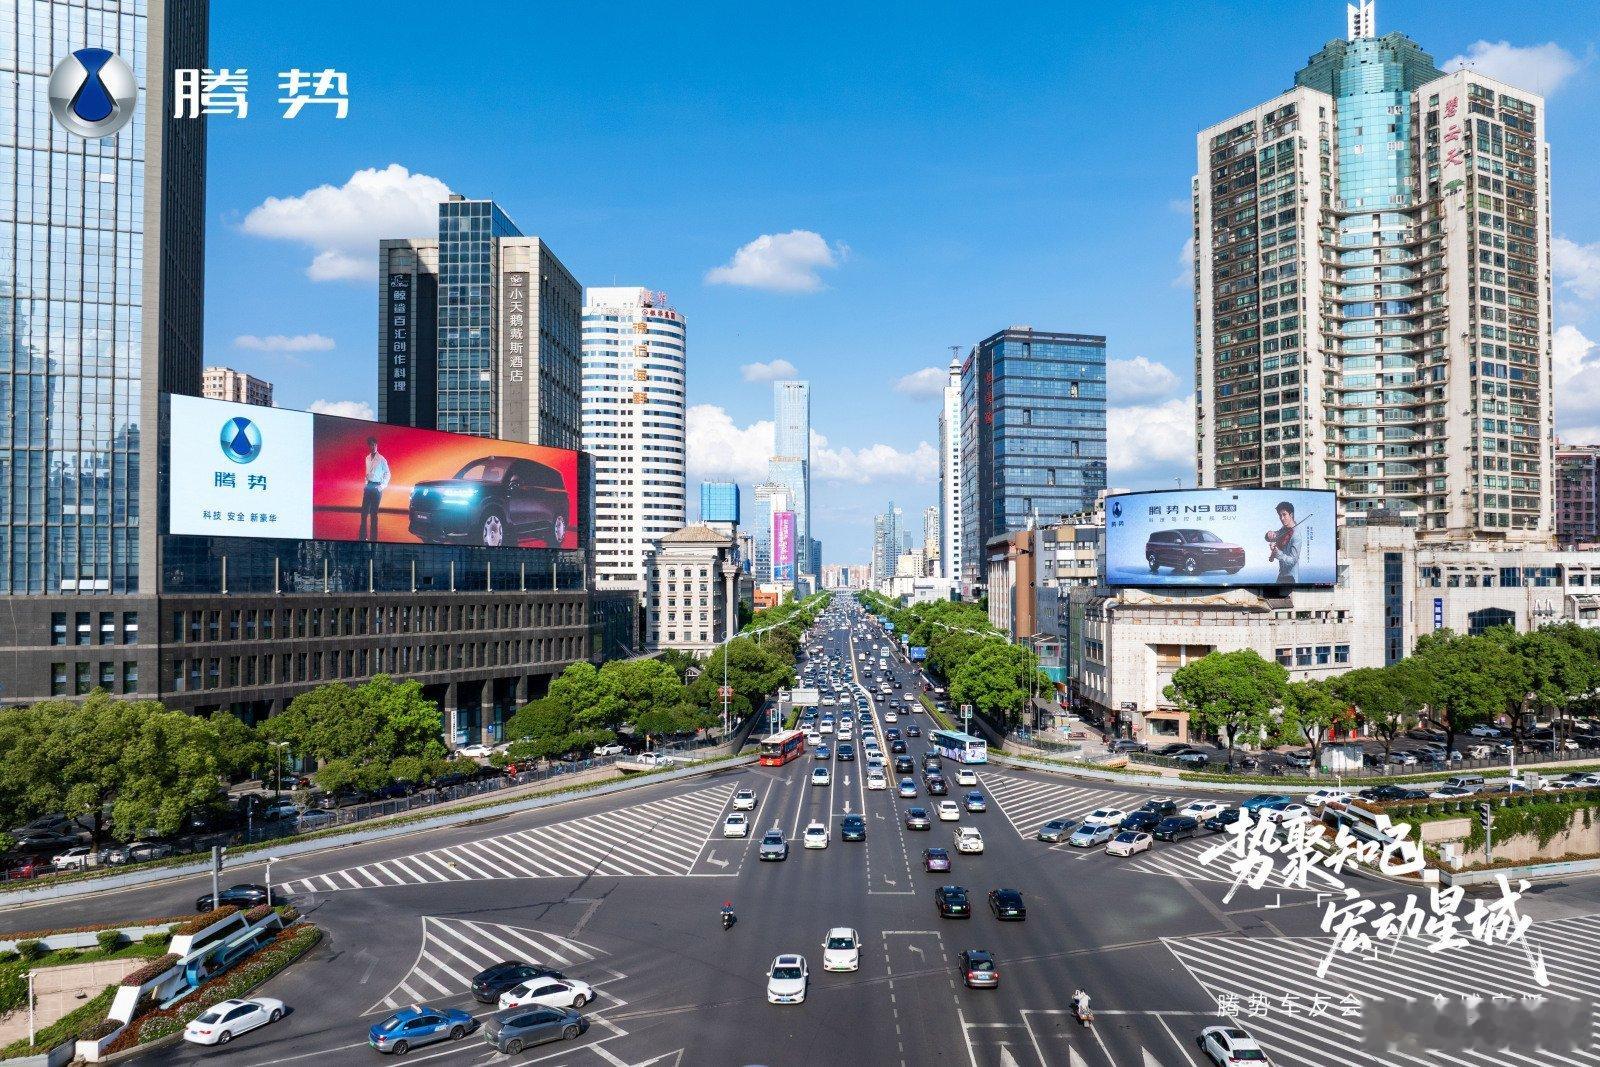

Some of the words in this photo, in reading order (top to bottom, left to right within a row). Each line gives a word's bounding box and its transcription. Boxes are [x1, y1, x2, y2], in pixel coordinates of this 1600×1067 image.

[1443, 97, 1463, 169] 碧云天
[509, 288, 523, 382] 小天鹅戴斯酒店
[214, 471, 267, 490] 腾势
[203, 510, 221, 520] 科技
[227, 512, 245, 522] 安全
[250, 512, 277, 523] 新豪华
[1149, 505, 1179, 515] 腾势
